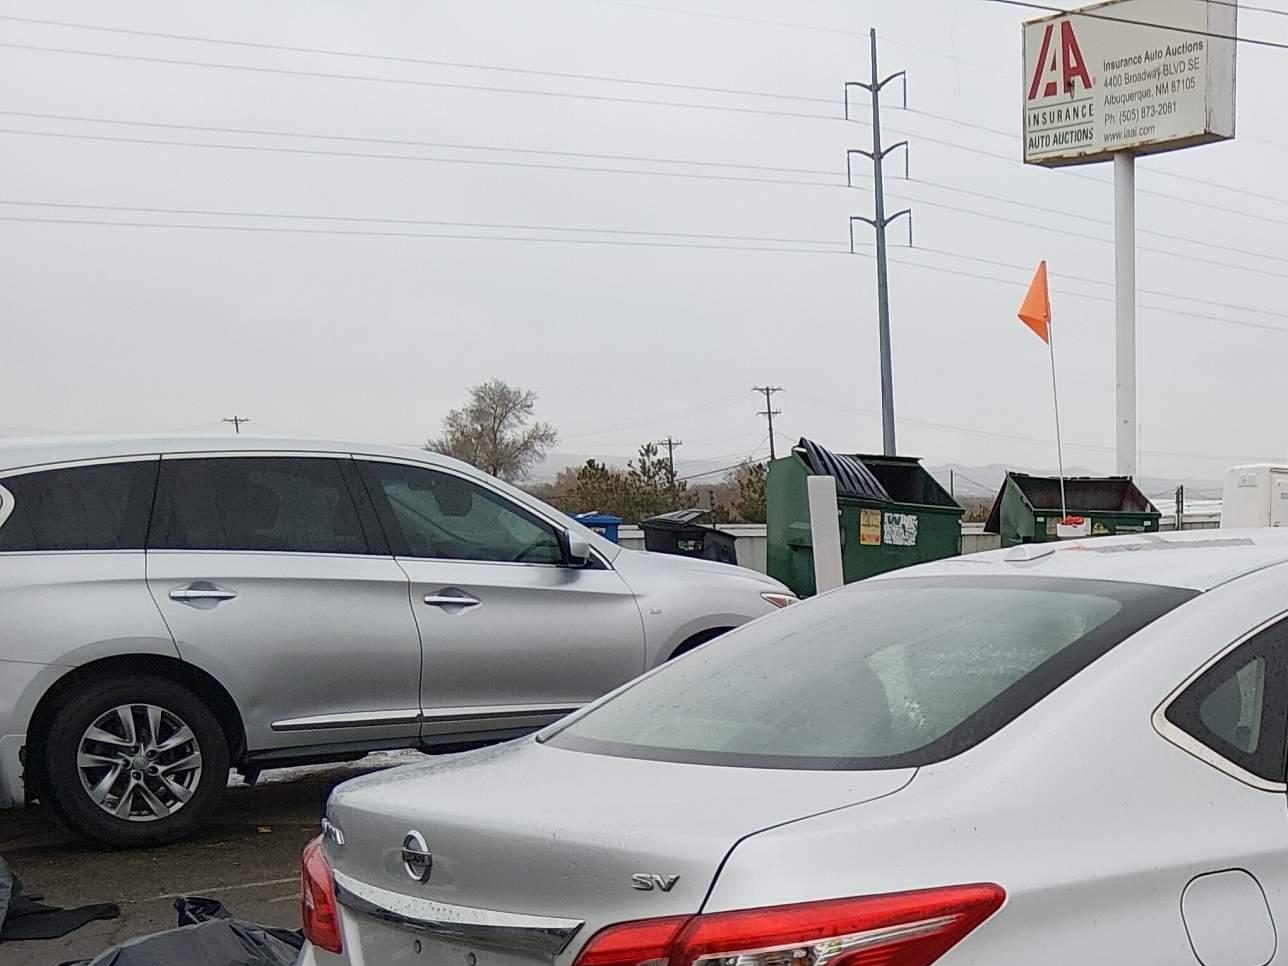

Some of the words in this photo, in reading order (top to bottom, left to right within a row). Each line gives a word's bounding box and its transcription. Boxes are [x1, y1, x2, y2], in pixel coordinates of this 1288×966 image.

[1103, 54, 1143, 72] Insurance
[1144, 49, 1163, 63] Auto
[1165, 40, 1204, 58] Auctions
[1103, 74, 1123, 88] 4400
[1162, 60, 1186, 77] BLVD
[1188, 56, 1200, 71] SE
[1155, 80, 1169, 96] NM
[1171, 76, 1196, 93] 87105
[1028, 103, 1094, 128] INSURANCE
[1119, 108, 1139, 125] (505)
[1028, 135, 1051, 152] AUTO
[1052, 127, 1094, 146] AUCTIONS
[631, 873, 681, 892] SV
